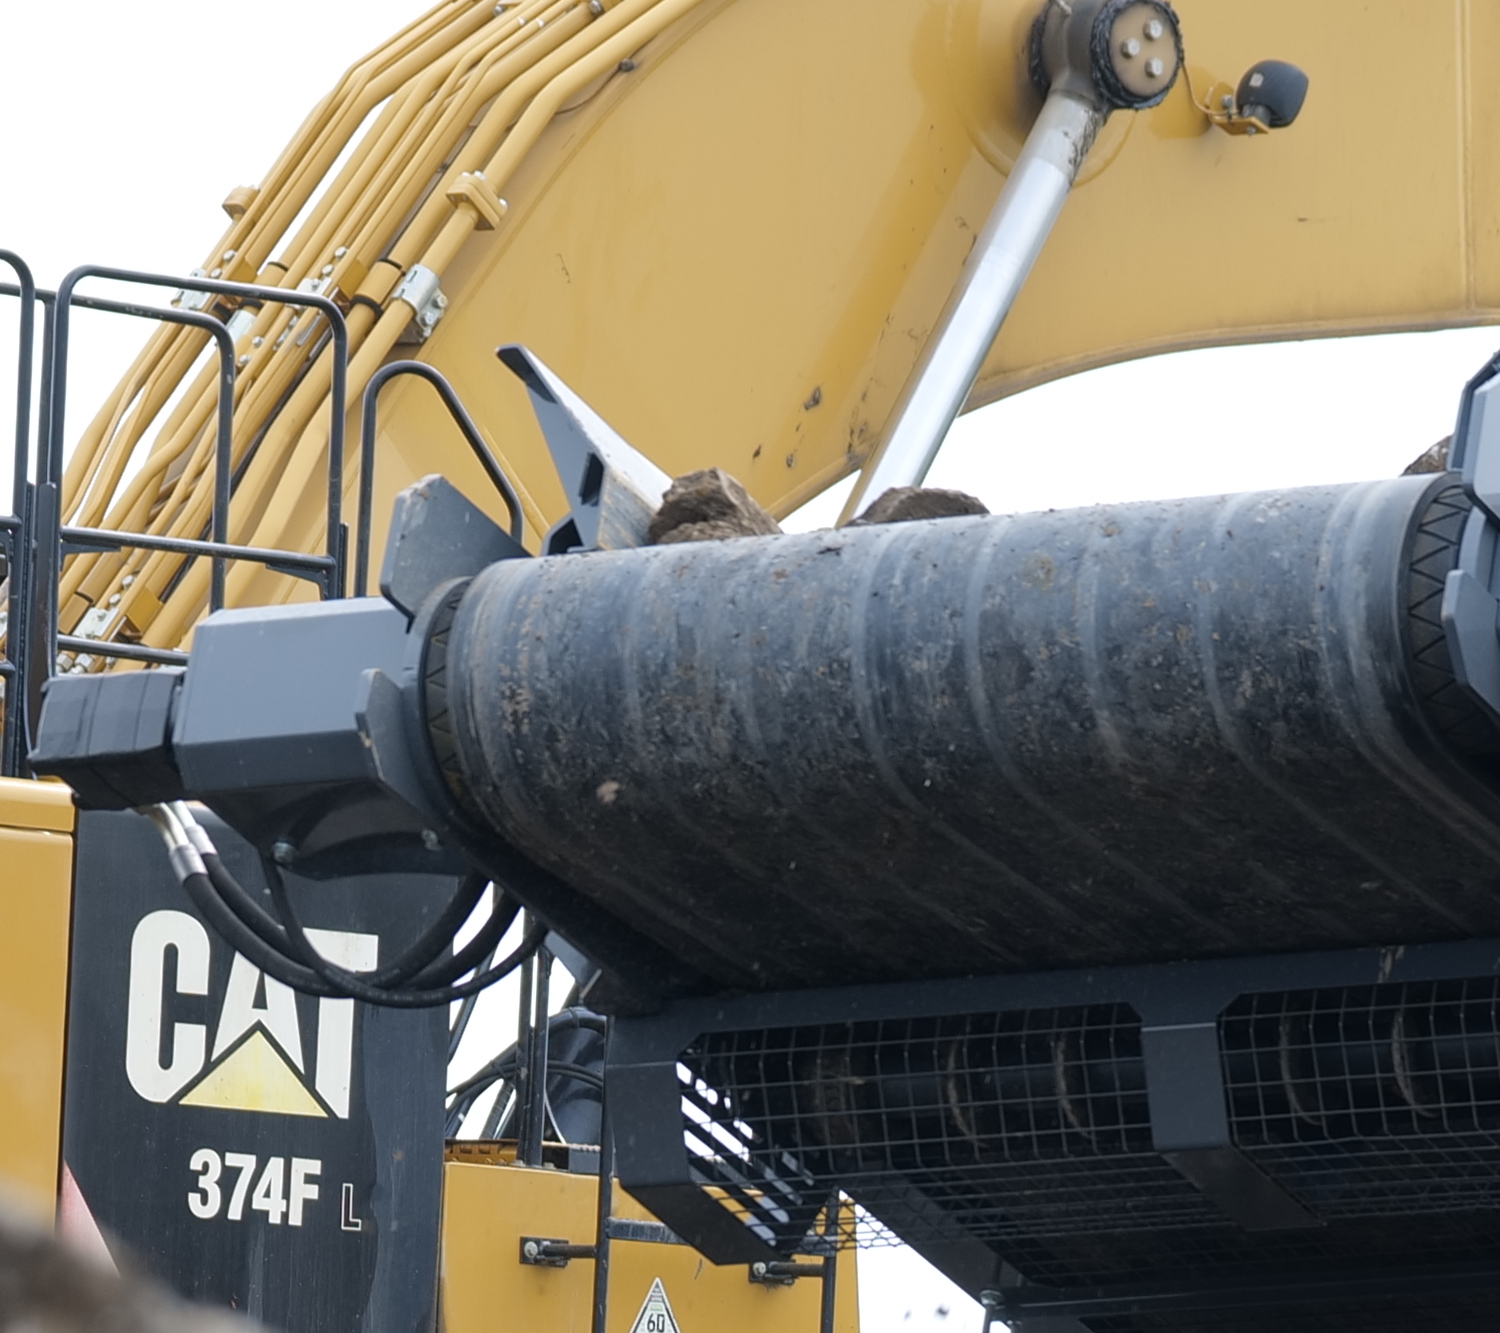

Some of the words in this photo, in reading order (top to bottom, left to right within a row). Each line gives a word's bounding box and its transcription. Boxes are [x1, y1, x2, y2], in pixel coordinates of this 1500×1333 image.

[126, 909, 378, 1119] CAT
[187, 1148, 321, 1226] 374F
[341, 1183, 361, 1231] L
[647, 1313, 665, 1333] 60
